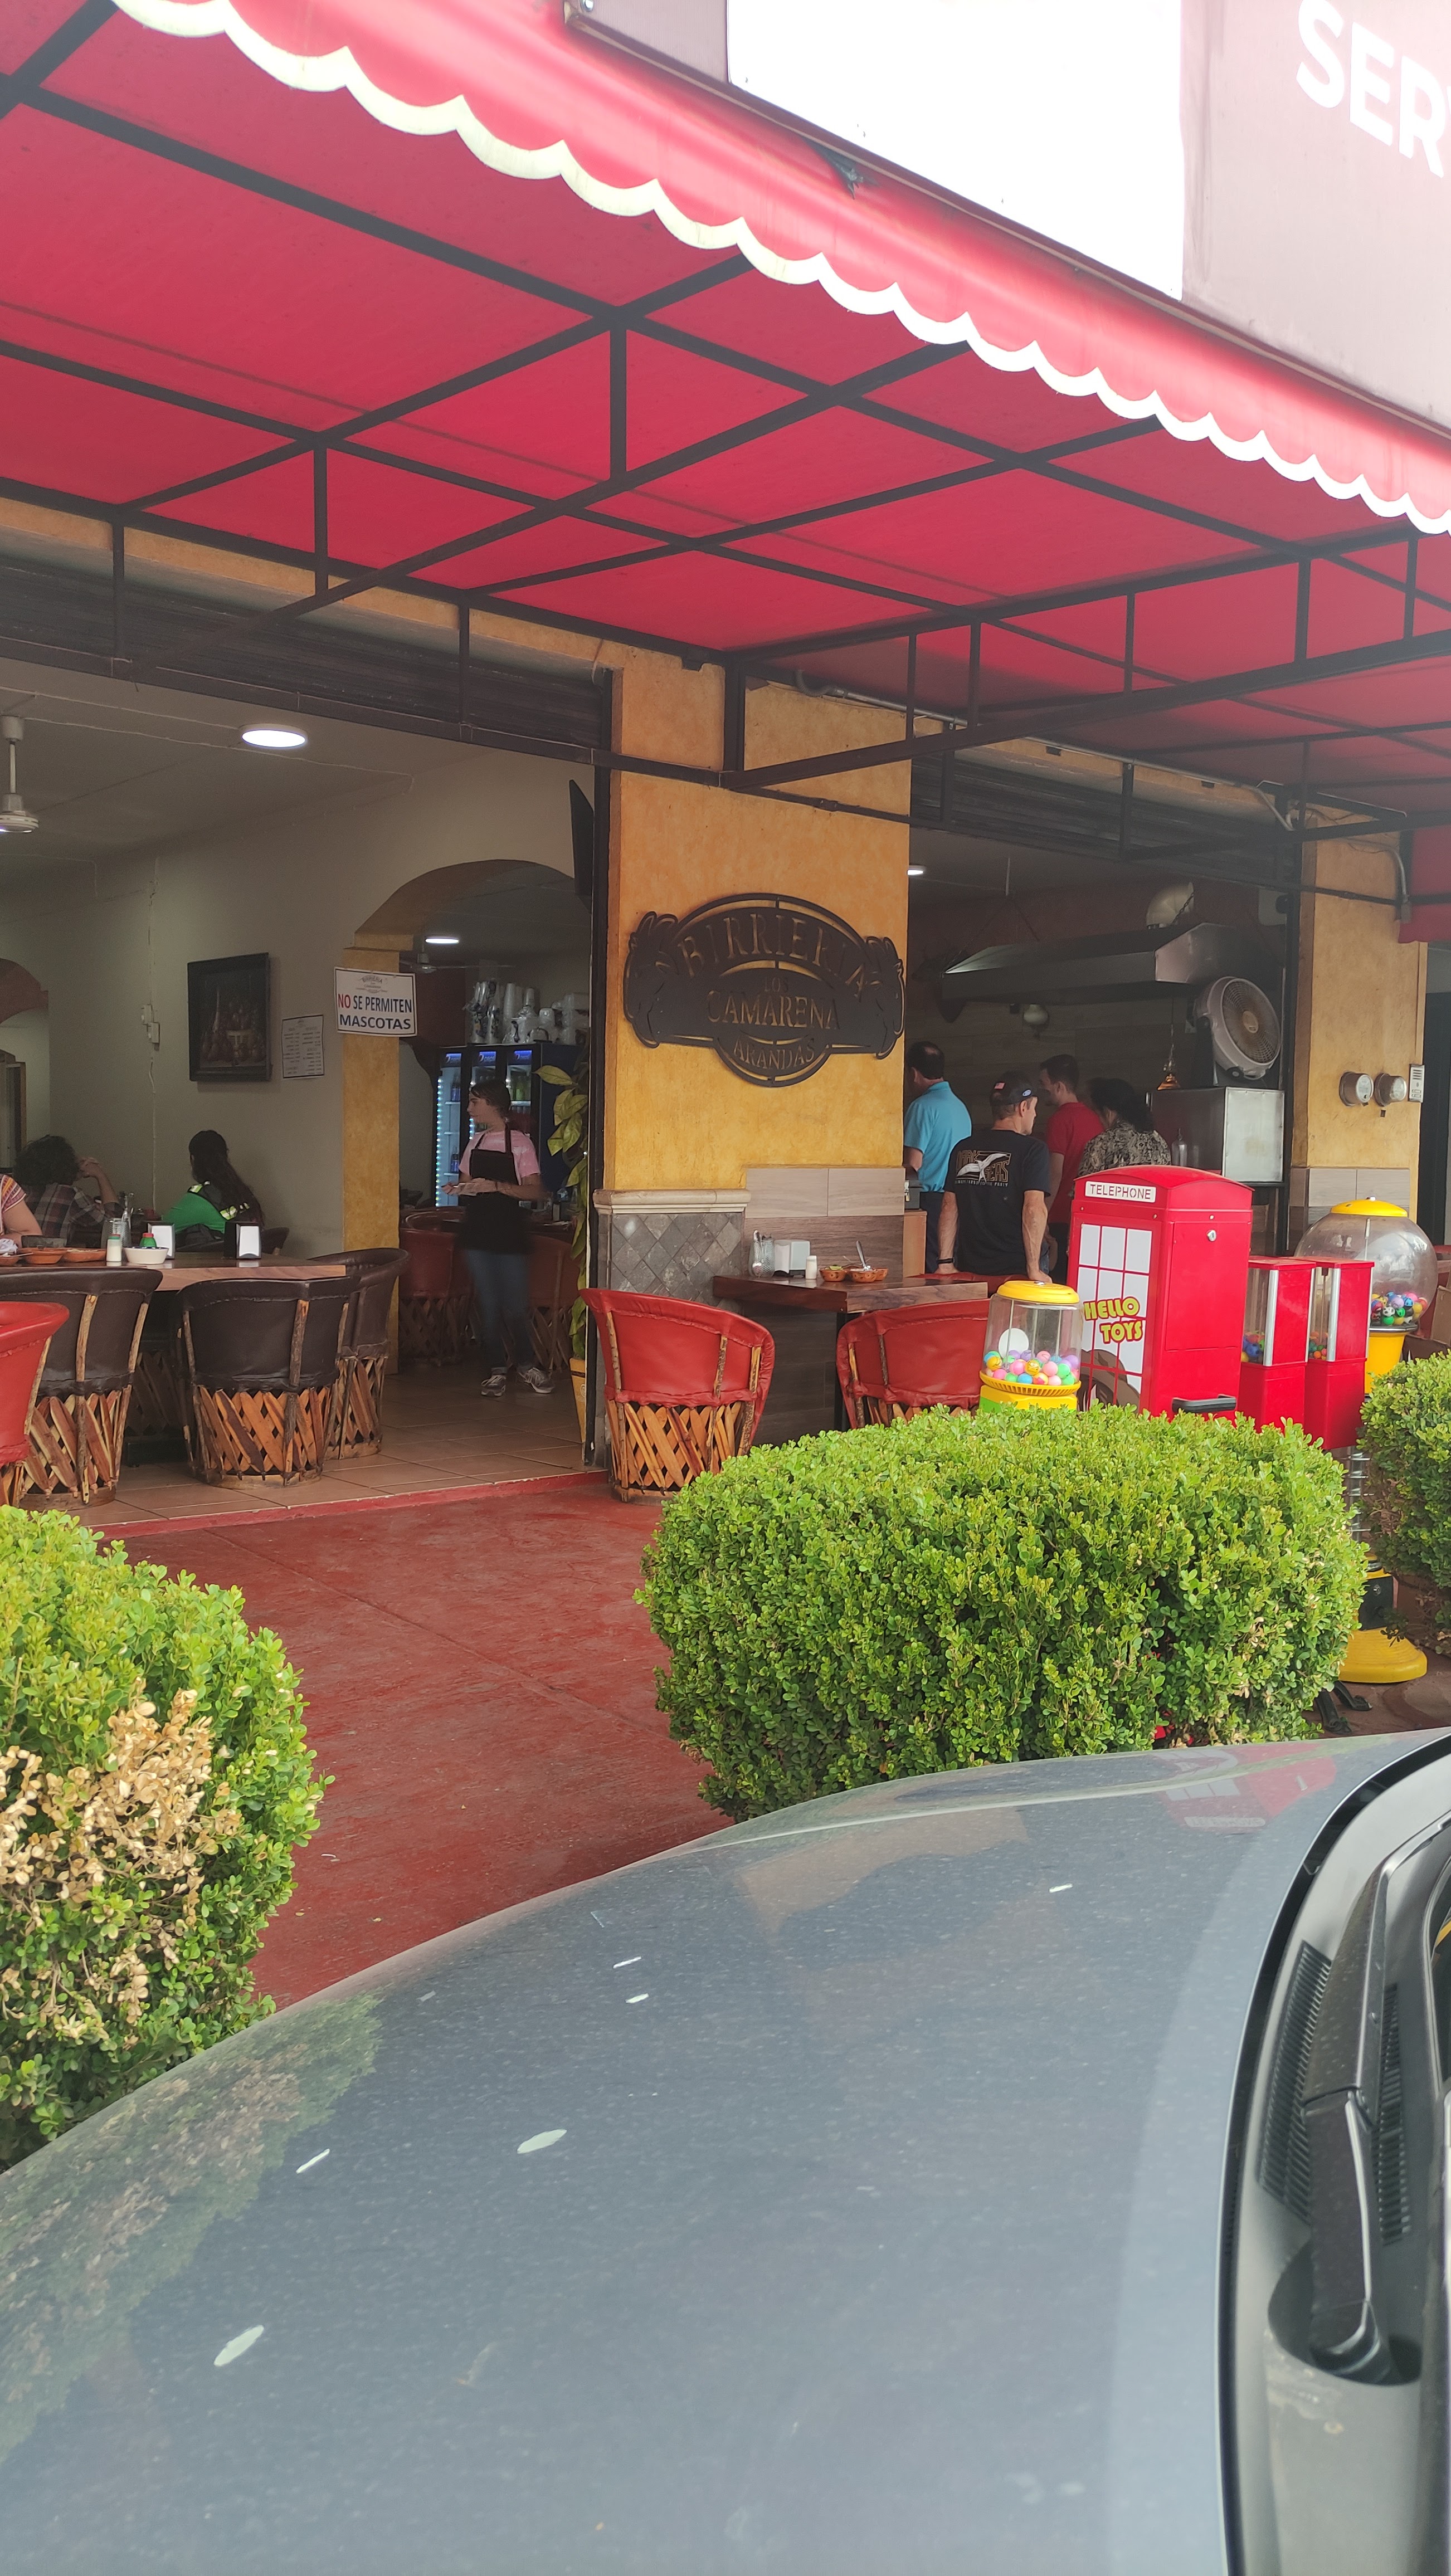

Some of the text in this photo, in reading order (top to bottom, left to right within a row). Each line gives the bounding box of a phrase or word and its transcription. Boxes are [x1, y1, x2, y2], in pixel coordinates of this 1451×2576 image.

[1296, 0, 1451, 178] SER
[678, 913, 865, 999] BIRRIERIA
[764, 977, 789, 993] LOS
[338, 993, 412, 1013] NO SE PERMITEN
[708, 990, 840, 1030] CAMARENA
[340, 1014, 411, 1030] MASCOTAS
[734, 1038, 815, 1070] ARANDAS
[1090, 1184, 1151, 1199] TELEPHONE
[1083, 1296, 1140, 1321] HELLO
[1099, 1320, 1143, 1344] TOYS
